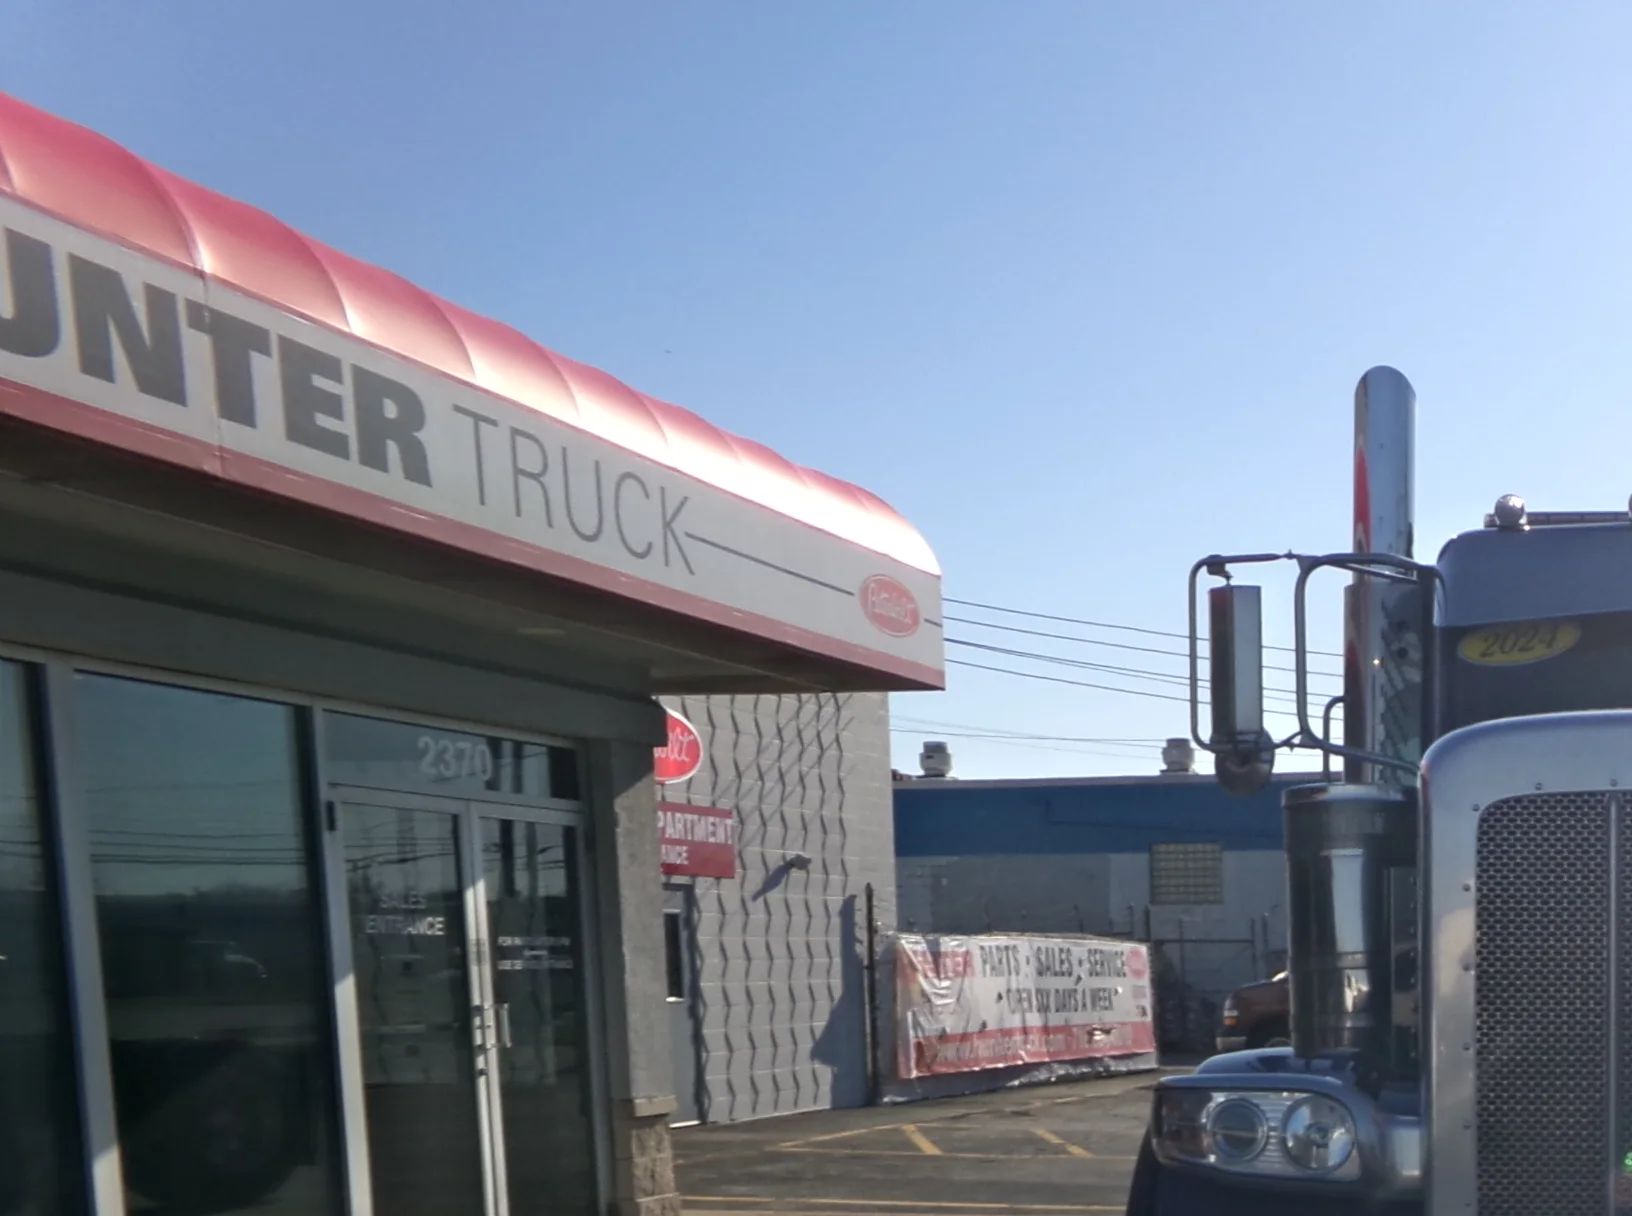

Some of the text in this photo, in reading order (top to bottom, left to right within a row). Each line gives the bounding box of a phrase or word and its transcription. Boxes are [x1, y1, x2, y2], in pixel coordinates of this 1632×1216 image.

[452, 402, 695, 576] TRUCK
[417, 736, 493, 781] 2370
[657, 810, 734, 845] PARTMENT
[366, 914, 446, 936] ENTRANCE
[979, 944, 1020, 977] PARTS
[1035, 946, 1074, 977] SALES
[1086, 947, 1127, 978] SERVICE
[1054, 988, 1079, 1013] DAYS
[1080, 988, 1088, 1012] A
